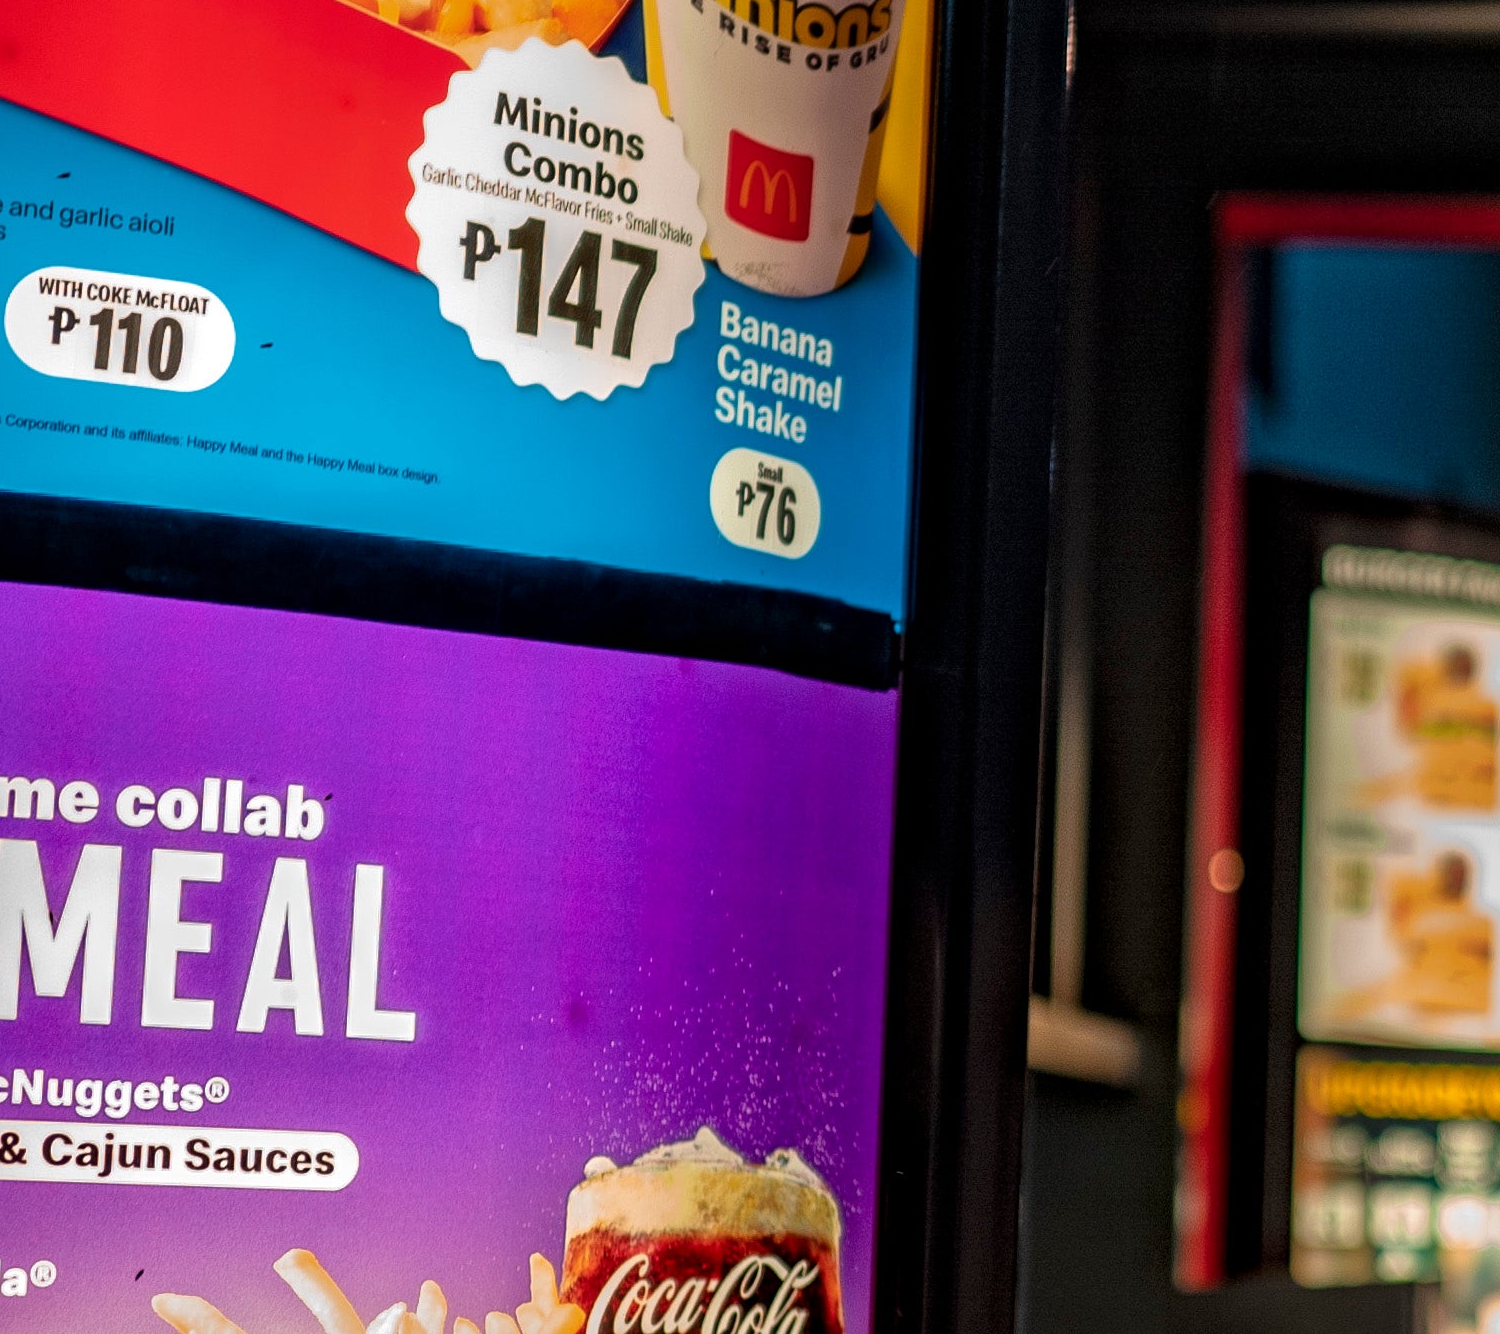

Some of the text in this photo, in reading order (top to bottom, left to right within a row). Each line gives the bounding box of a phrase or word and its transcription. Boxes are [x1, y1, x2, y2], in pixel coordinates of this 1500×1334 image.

[719, 11, 791, 64] RISE
[805, 52, 840, 72] OF
[850, 34, 890, 69] GRU
[493, 91, 644, 161] Minions
[422, 162, 462, 190] Garlic
[465, 172, 521, 201] Cheddar
[524, 185, 581, 215] McFlavor
[584, 202, 613, 225] Fries
[625, 212, 657, 235] Small
[659, 220, 693, 247] Shake
[504, 141, 638, 205] Combo
[9, 201, 54, 220] and
[60, 205, 123, 230] garlic
[129, 214, 175, 237] aioli
[39, 276, 209, 315] WITH COKE McFLOAT
[719, 300, 833, 369] Banana
[717, 344, 842, 412] Caramel
[5, 414, 80, 434] Corporation
[84, 424, 108, 437] and
[112, 426, 125, 439] its
[187, 435, 227, 454] Happy
[230, 440, 258, 456] Meal
[261, 446, 283, 460] and
[286, 449, 304, 463] the
[308, 452, 344, 470] Happy
[348, 458, 375, 473] Meal
[378, 463, 398, 477] box
[715, 386, 807, 444] Shake
[757, 461, 783, 485] Small
[114, 776, 326, 843] collab
[40, 1132, 172, 1180] Cajun
[182, 1136, 336, 1177] Sauces
